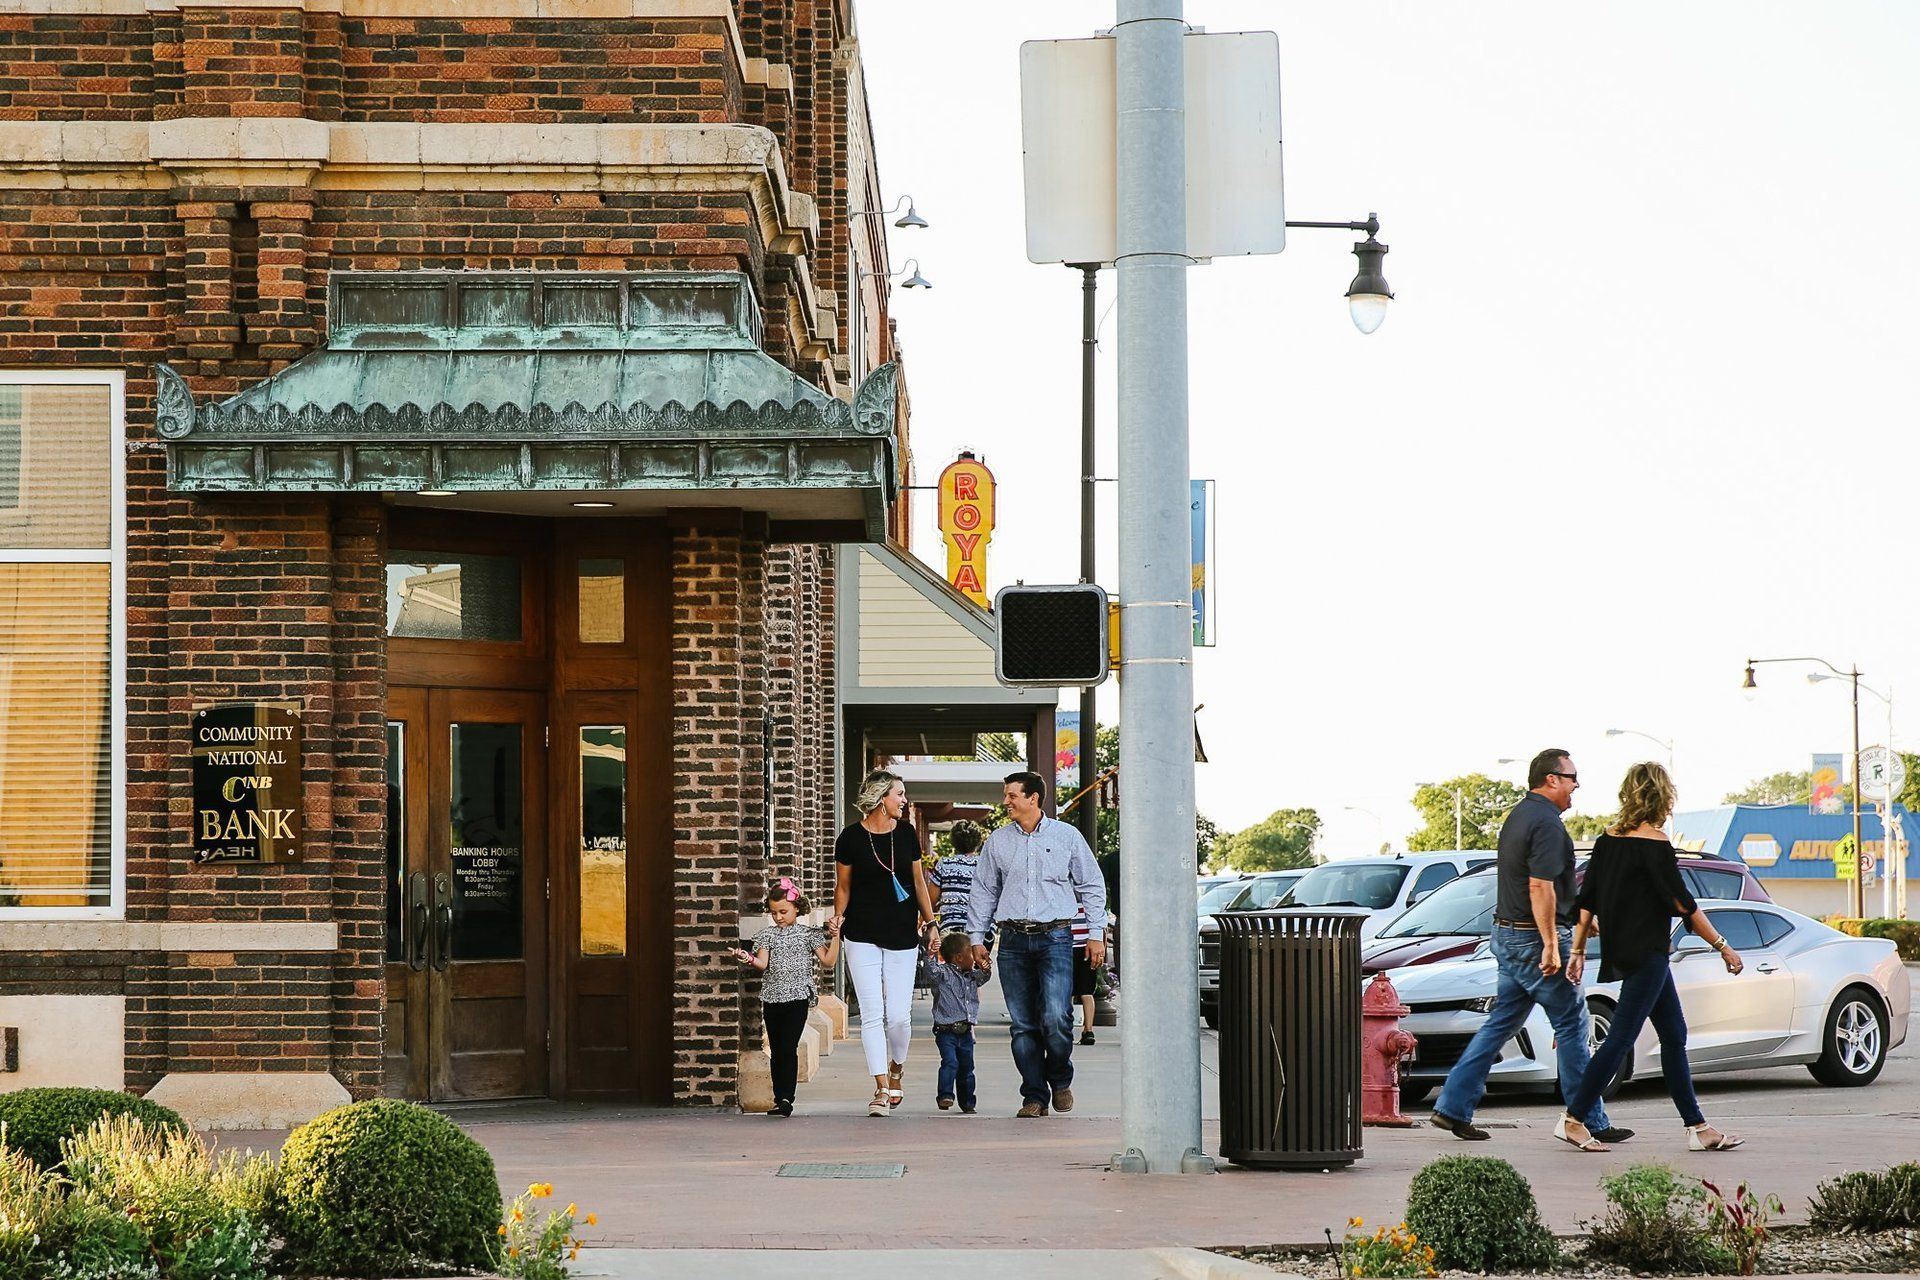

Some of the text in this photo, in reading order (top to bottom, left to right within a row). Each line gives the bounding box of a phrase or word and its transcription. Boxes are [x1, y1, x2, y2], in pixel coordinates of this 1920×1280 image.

[199, 726, 294, 742] COMMUNITY
[207, 750, 287, 766] NATIONAL
[222, 776, 273, 803] CNB
[199, 809, 296, 840] BANK
[452, 847, 519, 857] BANKING HOURS
[472, 858, 499, 867] LOBBY
